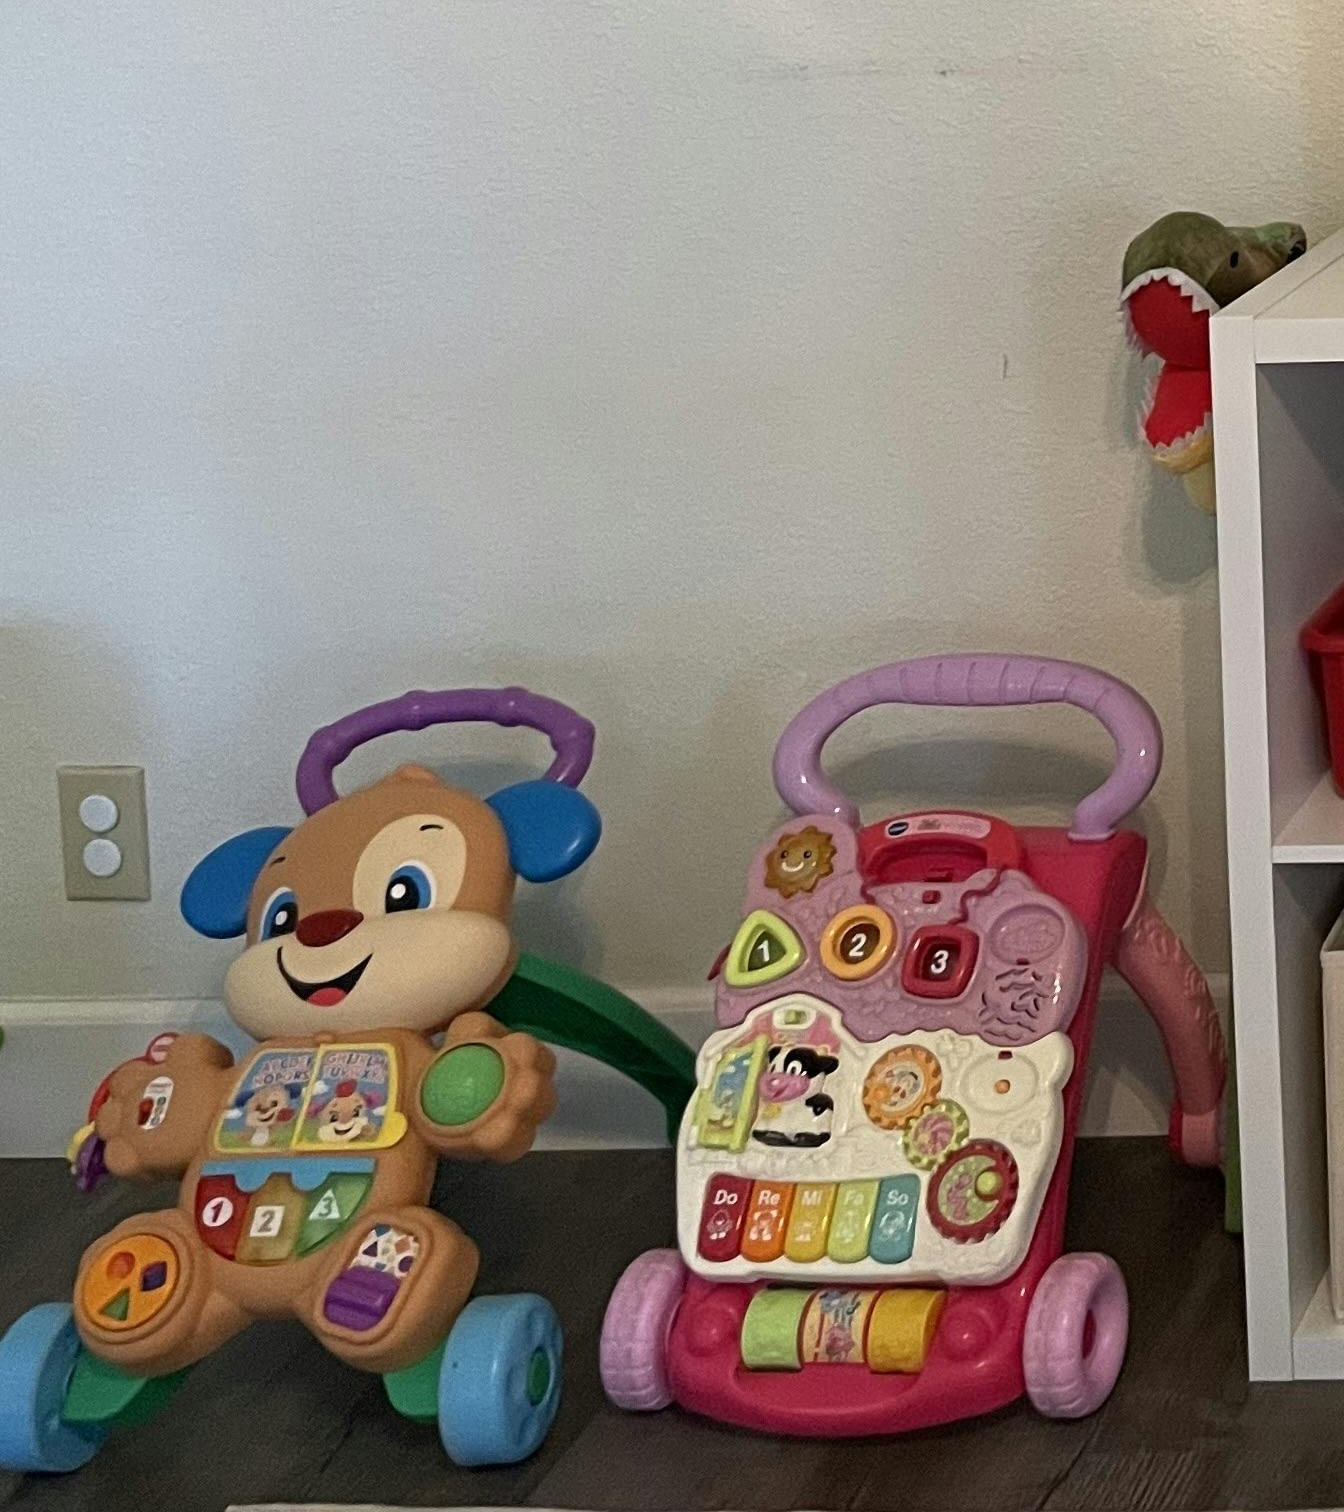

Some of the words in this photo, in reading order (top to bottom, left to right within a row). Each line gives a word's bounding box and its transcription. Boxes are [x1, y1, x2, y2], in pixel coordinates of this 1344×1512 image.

[757, 940, 770, 961] 1
[849, 933, 866, 957] 2
[930, 949, 948, 974] 3
[318, 1196, 333, 1217] 3
[713, 1189, 739, 1206] Do
[757, 1190, 781, 1206] Re
[801, 1190, 822, 1205] Mi
[843, 1190, 865, 1205] Fa
[886, 1189, 909, 1206] So
[211, 1201, 223, 1223] 1
[257, 1210, 275, 1232] 2
